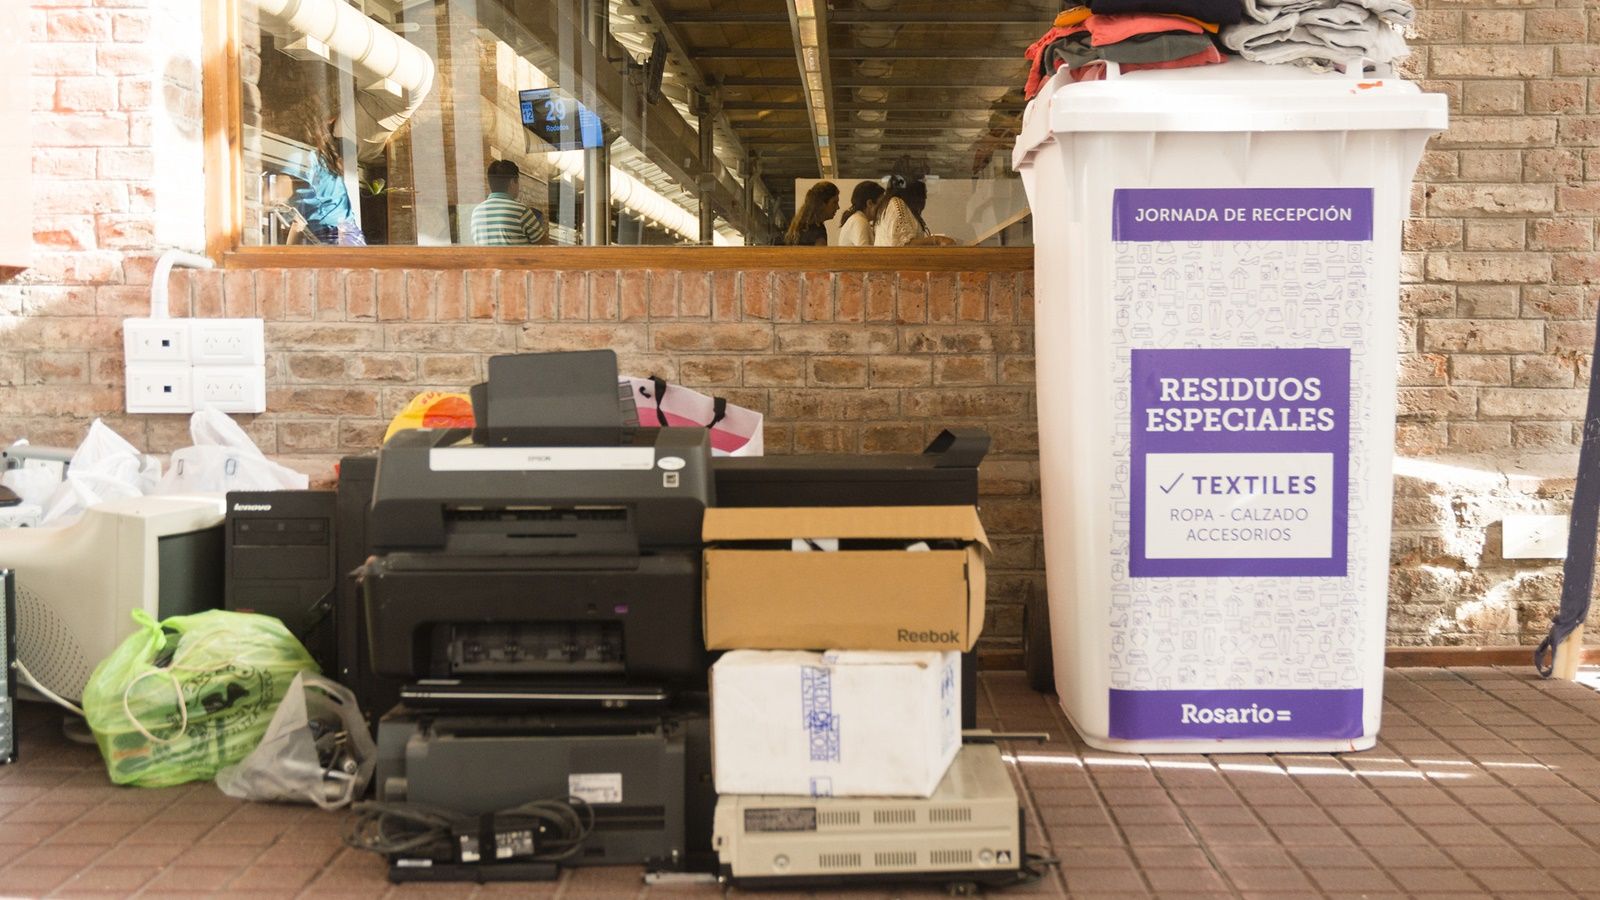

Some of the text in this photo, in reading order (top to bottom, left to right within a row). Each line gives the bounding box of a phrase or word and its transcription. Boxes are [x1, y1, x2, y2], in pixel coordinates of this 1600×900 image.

[523, 109, 533, 121] 12
[544, 100, 566, 121] 29
[1135, 205, 1352, 222] JORNADA DE RECEPCIÓN
[1159, 377, 1322, 402] RESIDUOS
[1145, 407, 1335, 432] ESPECIALES
[1192, 475, 1317, 495] TEXTILES
[233, 503, 272, 511] lenovo
[1170, 508, 1214, 522] ROPA
[1230, 508, 1309, 522] CALZADO
[1186, 528, 1292, 542] ACCESORIOS
[897, 628, 960, 643] Reebok
